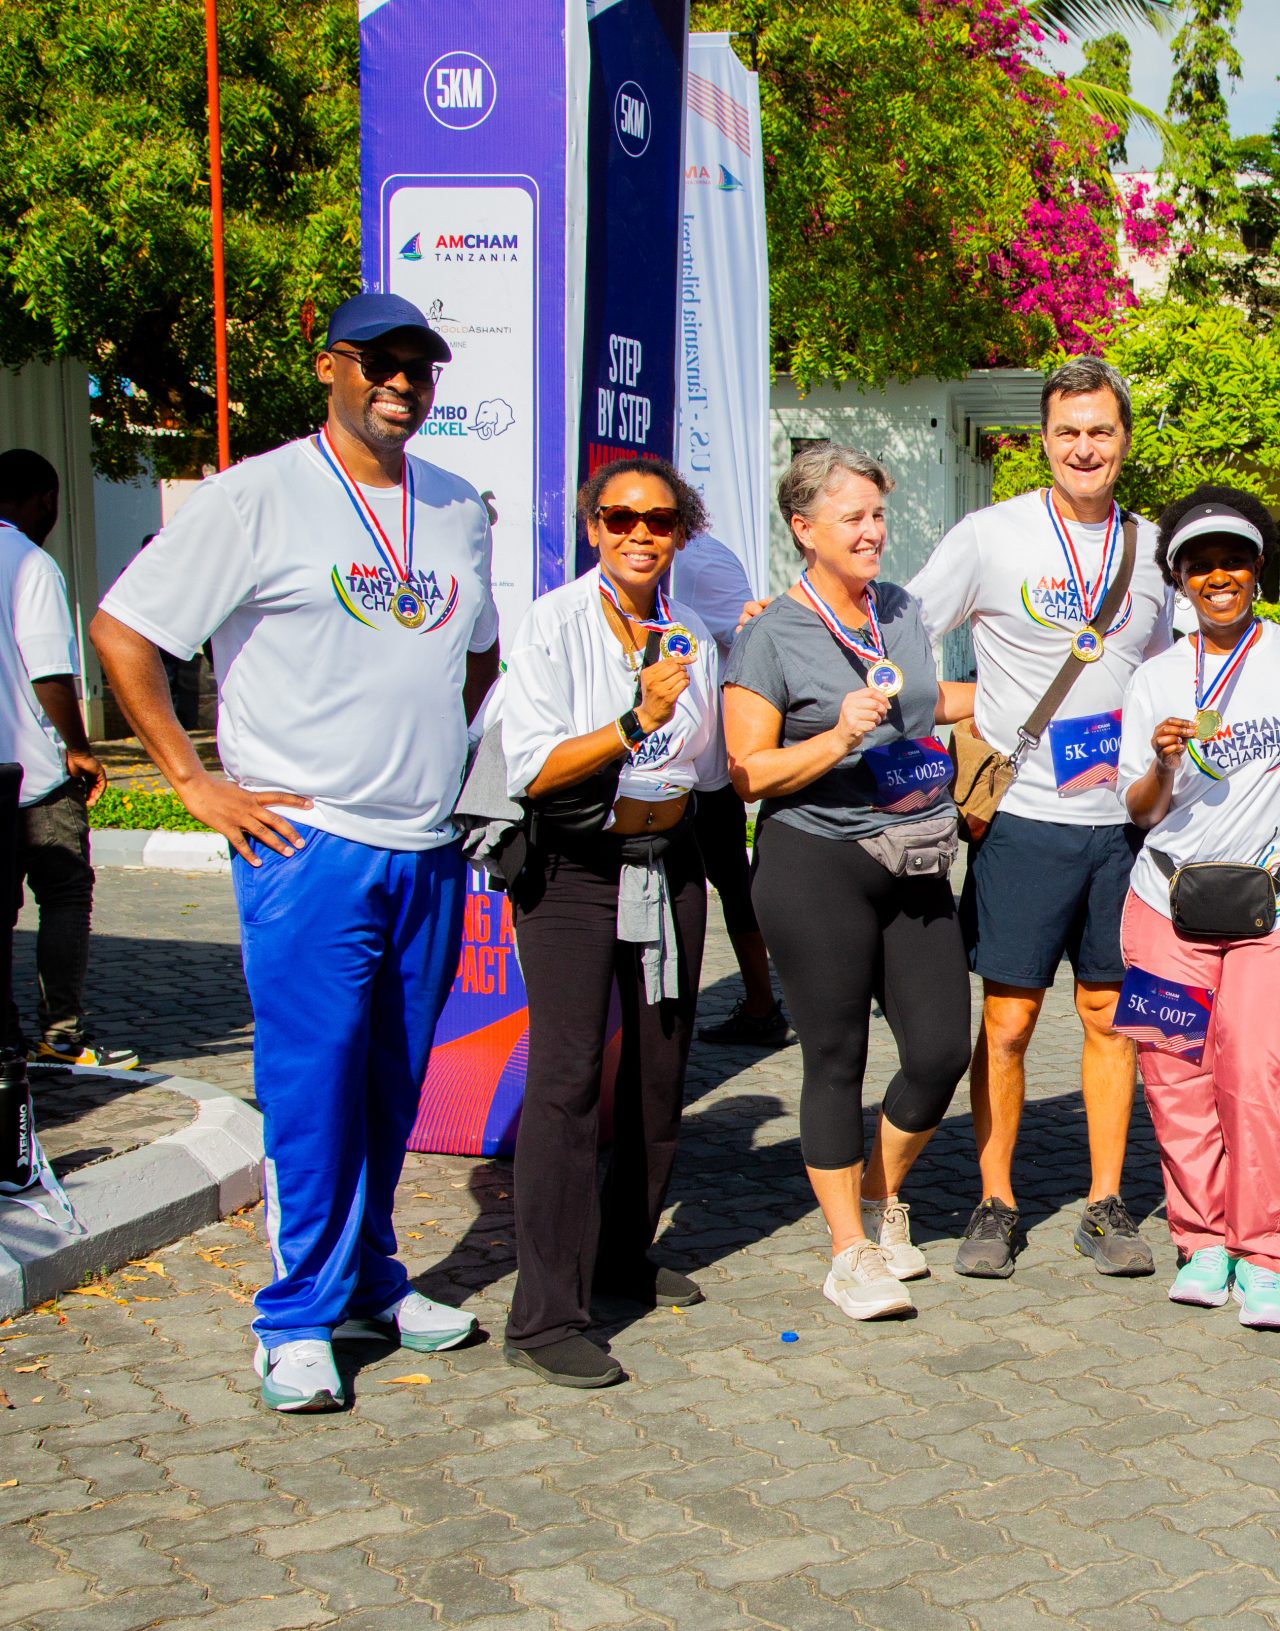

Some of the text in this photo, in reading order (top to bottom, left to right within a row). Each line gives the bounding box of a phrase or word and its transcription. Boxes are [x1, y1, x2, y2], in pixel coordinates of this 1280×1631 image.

[436, 68, 483, 108] 5KM
[620, 93, 645, 139] 5KM
[435, 234, 518, 249] AMCHAM
[435, 253, 518, 262] TANZANIA
[433, 325, 512, 334] OGOLDASHANTI
[609, 333, 642, 387] STEP
[427, 406, 468, 420] MBO
[597, 387, 651, 444] BY STEP
[349, 562, 438, 585] AMCAM
[345, 575, 445, 601] TANZNIA
[1065, 742, 1089, 761] 5K
[886, 769, 908, 787] 5K
[914, 760, 946, 781] 0025
[1127, 993, 1150, 1015] 5K
[1159, 1006, 1197, 1028] 0017
